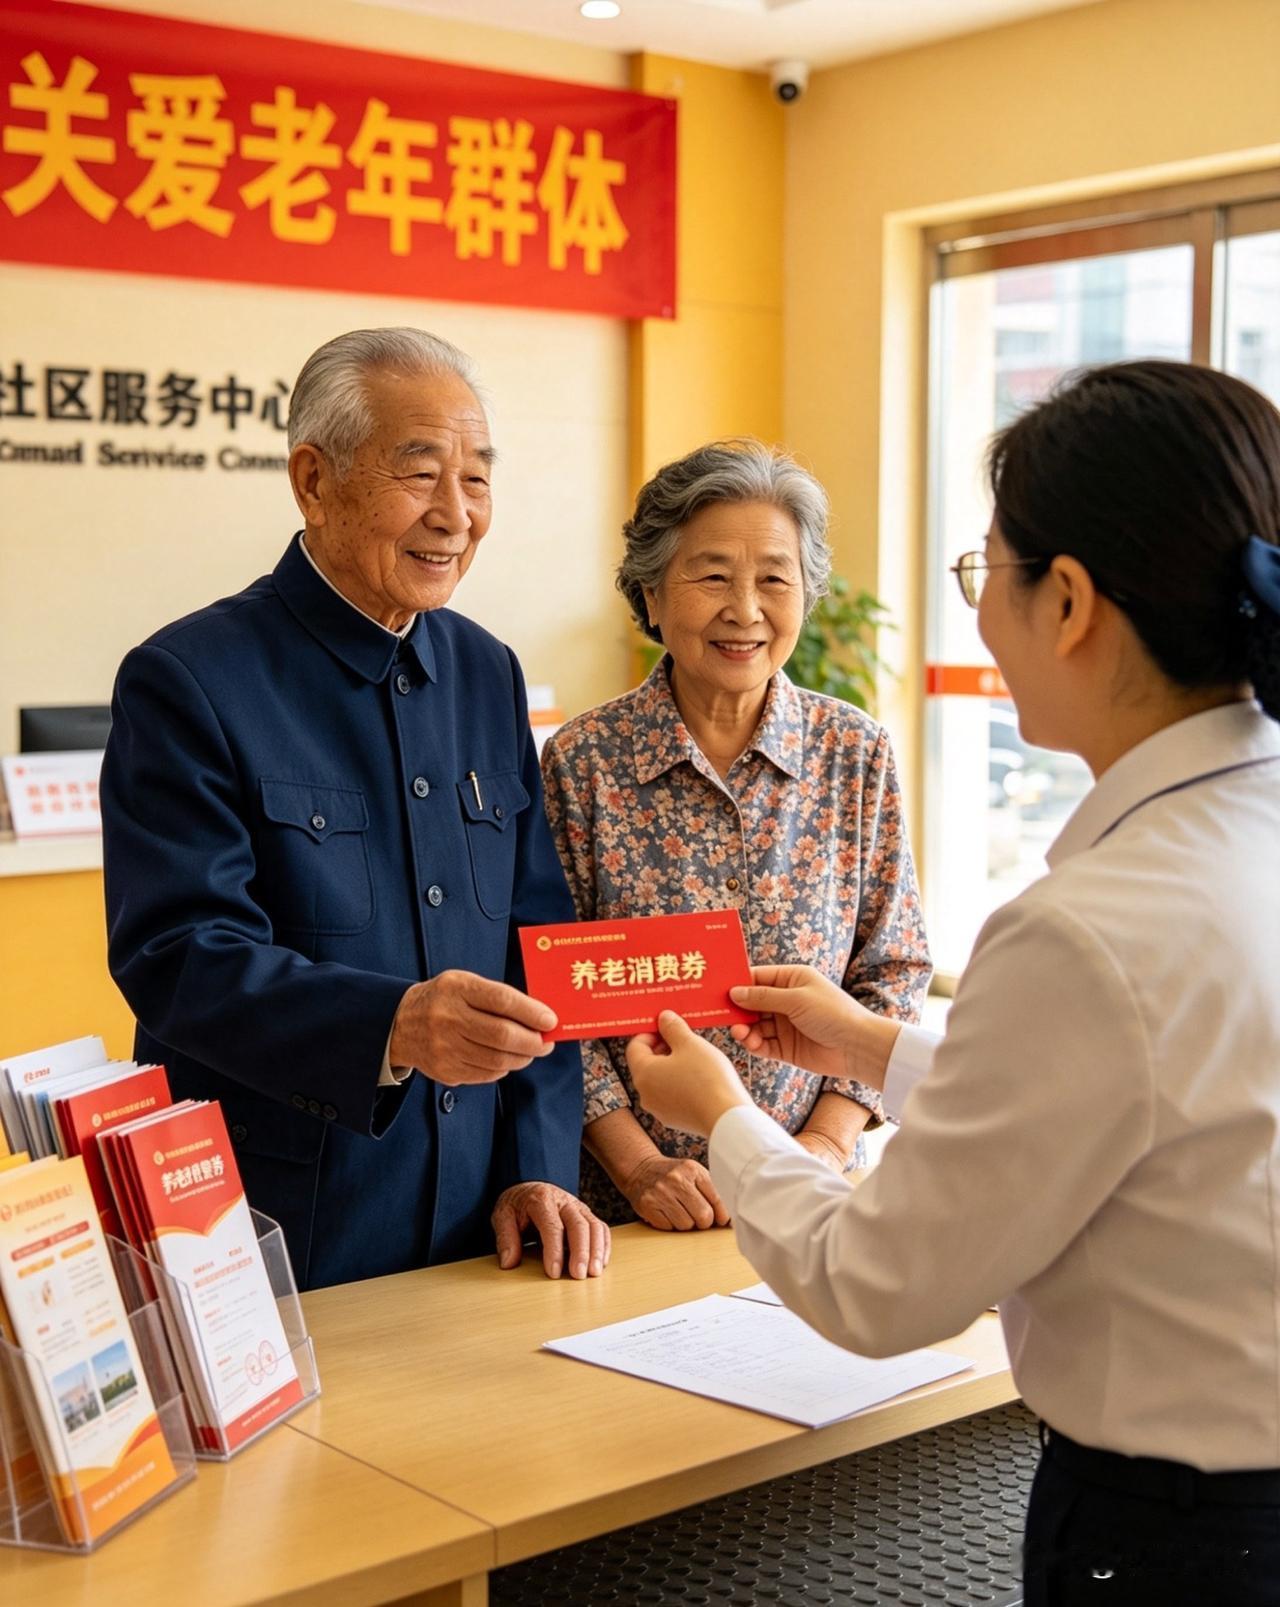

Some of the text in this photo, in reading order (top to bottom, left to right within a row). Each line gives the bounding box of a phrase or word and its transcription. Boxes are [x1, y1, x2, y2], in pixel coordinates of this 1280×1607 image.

[3, 51, 628, 275] 关爱老年群体
[570, 950, 707, 990] 养老消费券
